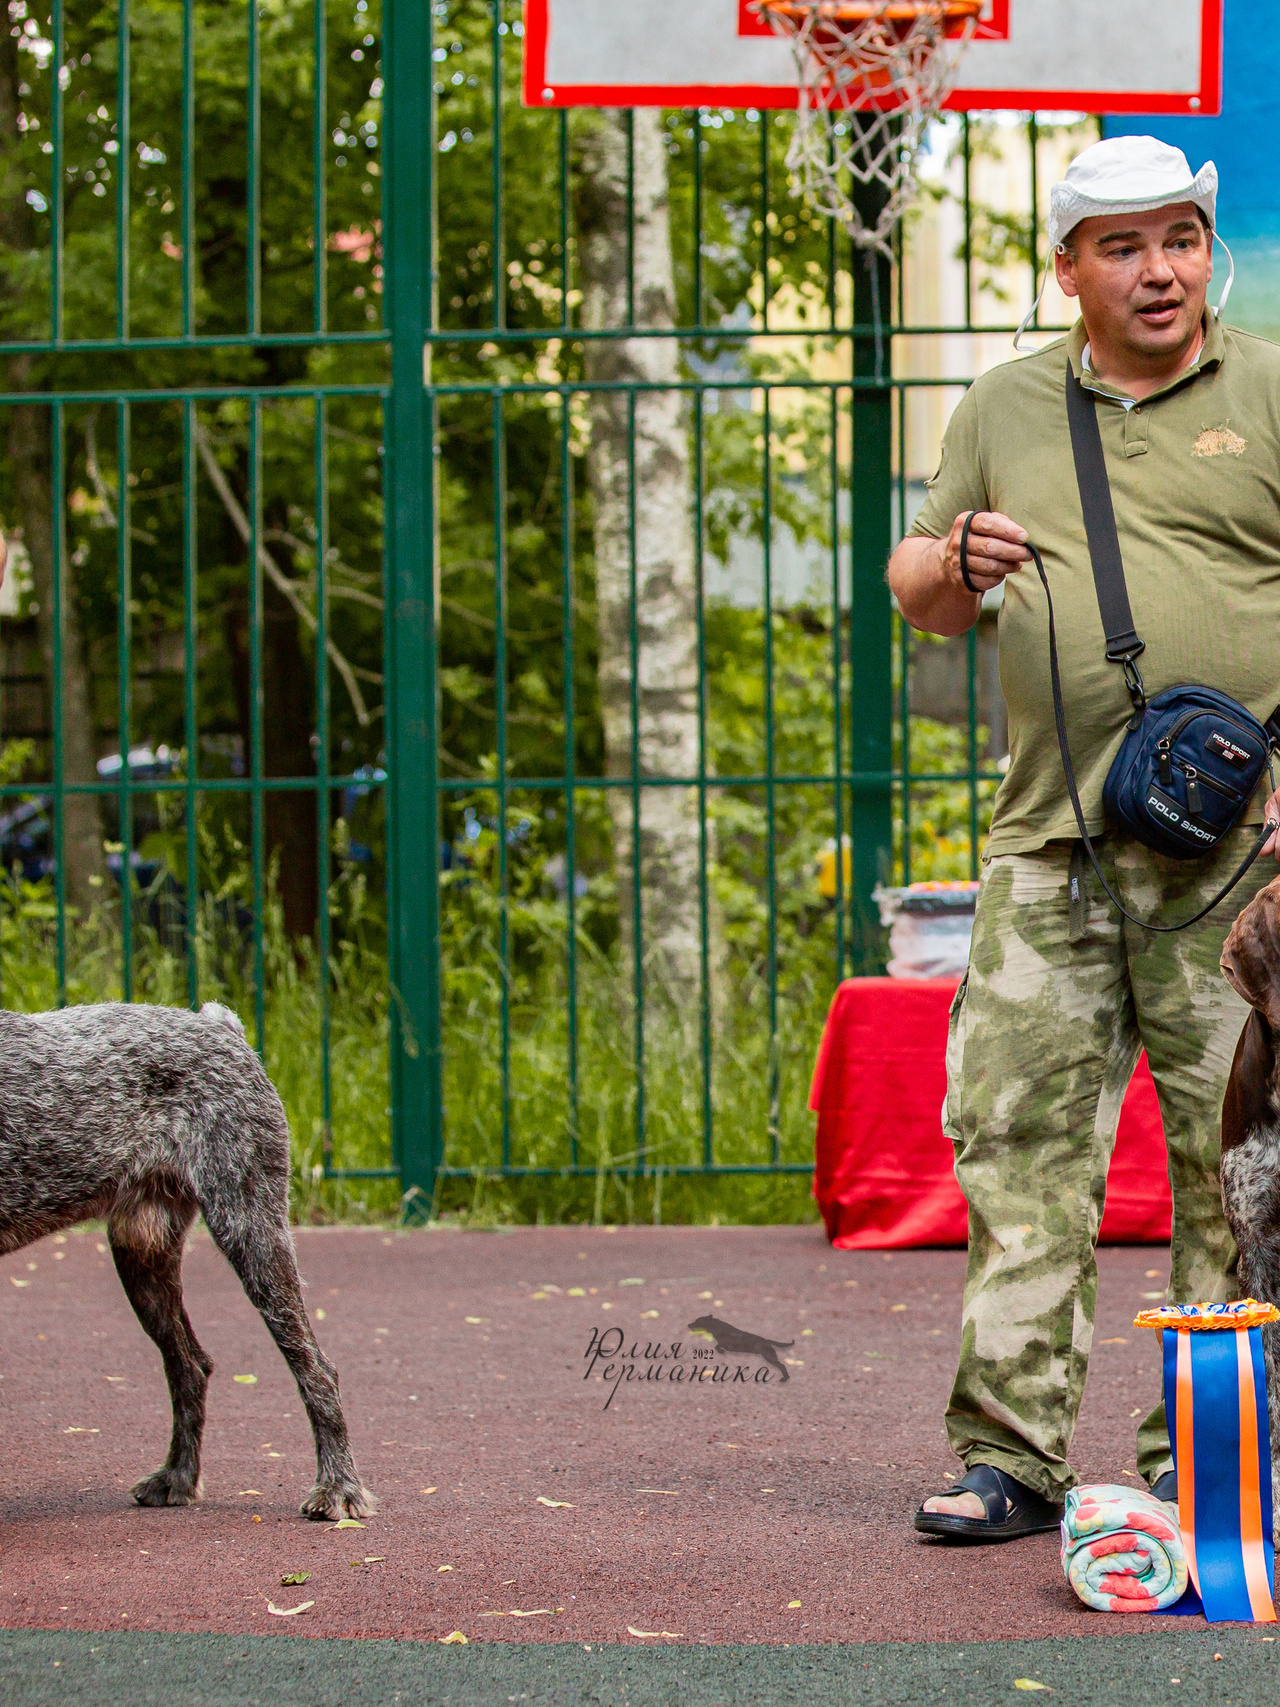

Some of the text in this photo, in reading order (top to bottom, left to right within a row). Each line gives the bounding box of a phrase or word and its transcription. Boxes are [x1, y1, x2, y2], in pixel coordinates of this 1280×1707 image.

[1212, 733, 1231, 747] POLO
[1230, 744, 1251, 759] SPORT
[1147, 796, 1217, 844] POLO SPORT
